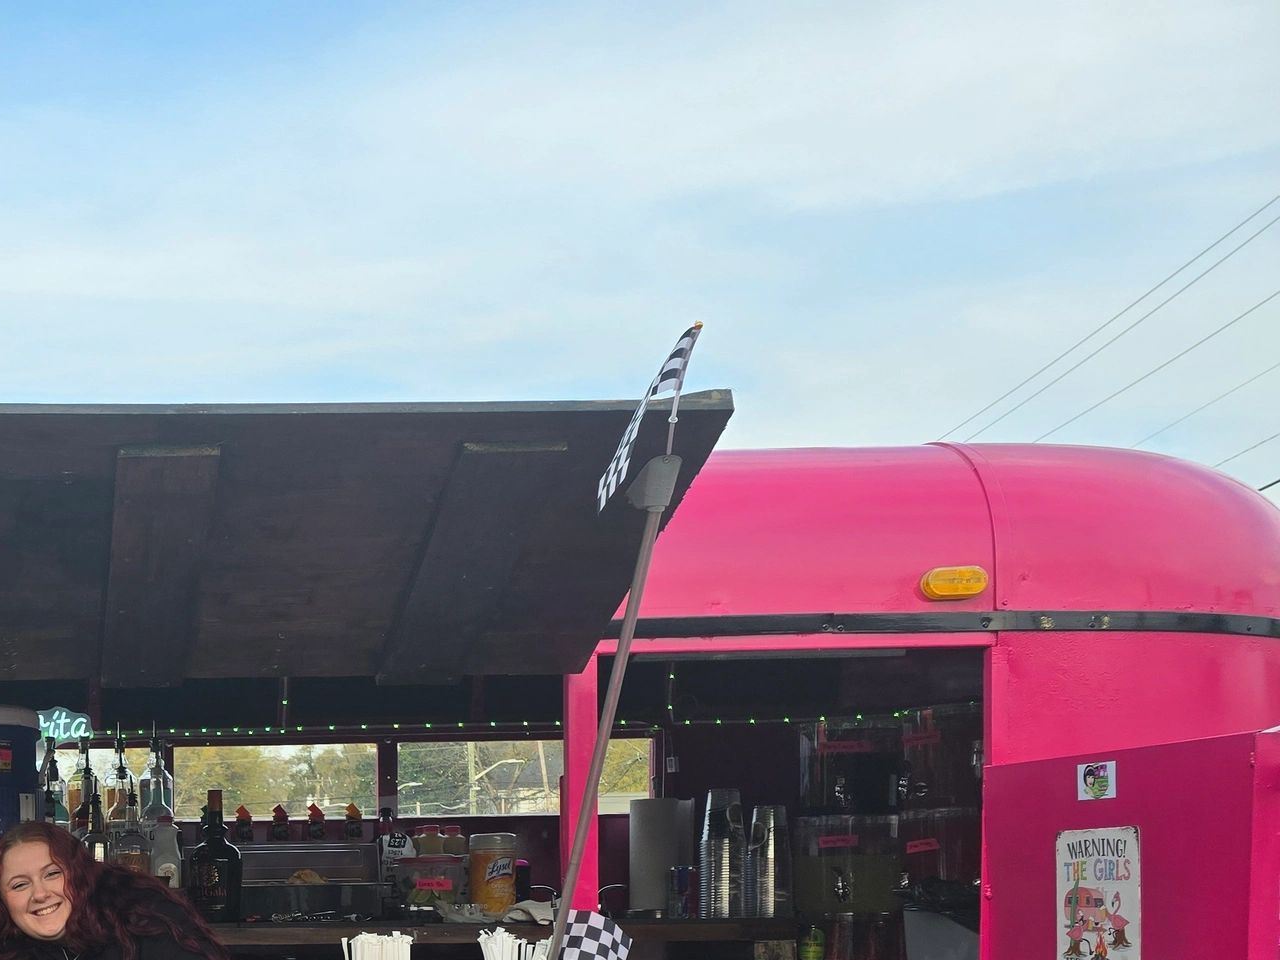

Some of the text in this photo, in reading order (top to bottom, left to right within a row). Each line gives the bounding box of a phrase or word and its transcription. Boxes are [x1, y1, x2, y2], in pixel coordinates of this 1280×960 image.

[1067, 838, 1127, 859] WARNING!
[488, 859, 512, 876] Lysol
[1064, 858, 1131, 882] THE GIRLS
